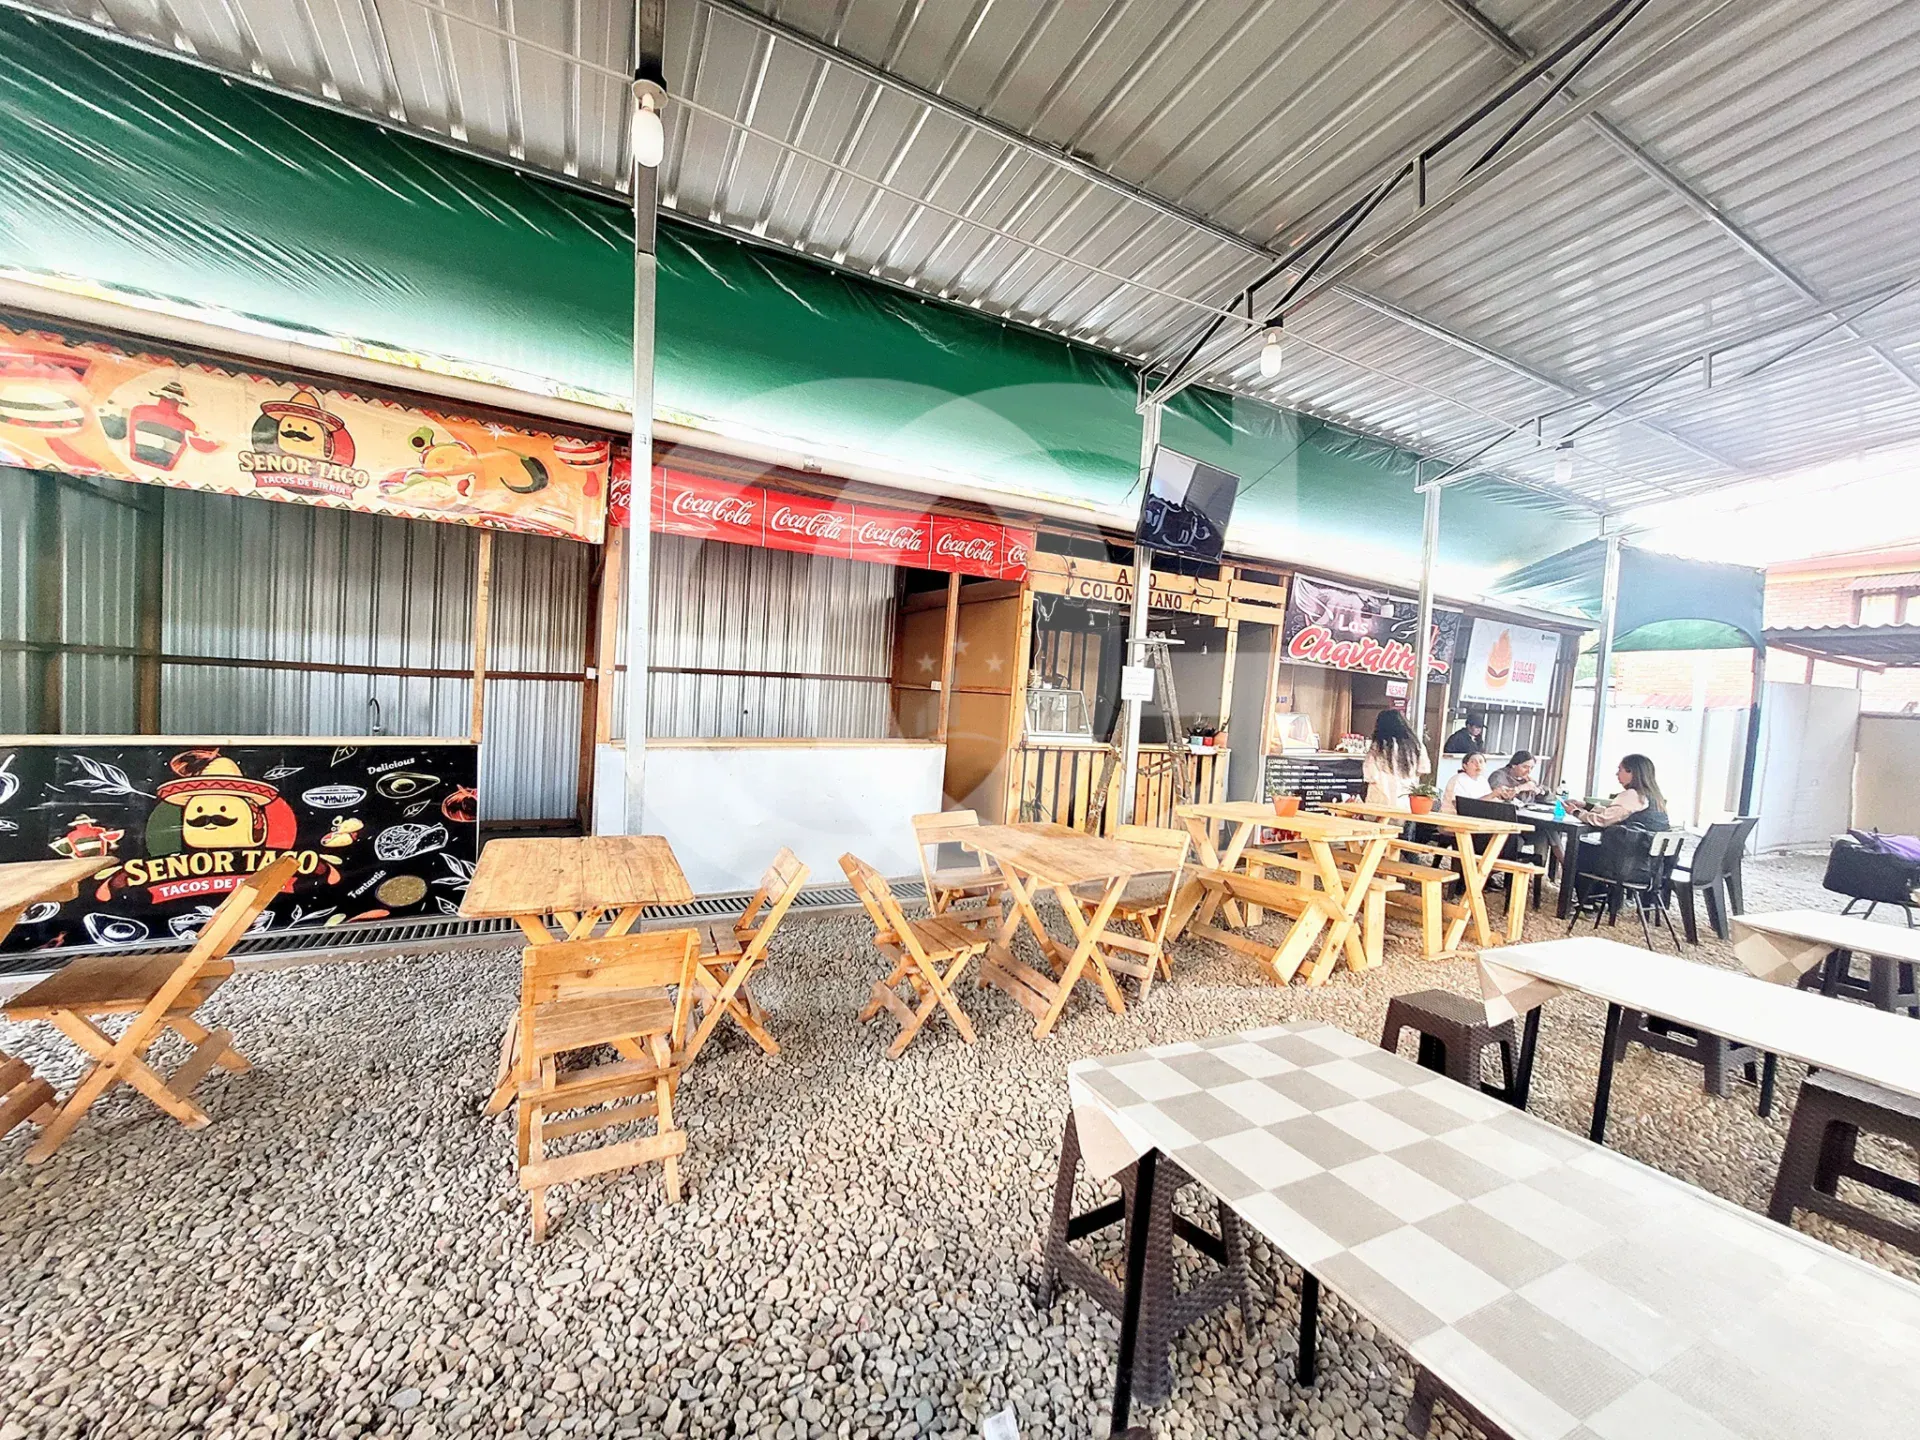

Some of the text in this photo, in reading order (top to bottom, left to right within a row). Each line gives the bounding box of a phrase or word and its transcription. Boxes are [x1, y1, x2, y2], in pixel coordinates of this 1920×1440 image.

[262, 475, 346, 495] TACOS DE BIRRIA
[315, 460, 369, 488] TACO
[672, 491, 757, 527] Coca-Cola
[770, 507, 847, 540] Coca-Cola
[858, 520, 925, 552] Coca-Cola
[936, 533, 998, 562] Coca-Cola
[1080, 581, 1182, 610] COLOMIANO
[1338, 613, 1369, 636] Las
[1627, 717, 1660, 730] BAÑO
[367, 757, 415, 775] Delicious
[124, 850, 234, 887] SEÑOR
[159, 881, 210, 898] TACOS
[214, 878, 232, 888] DE
[347, 869, 387, 899] Fantastic
